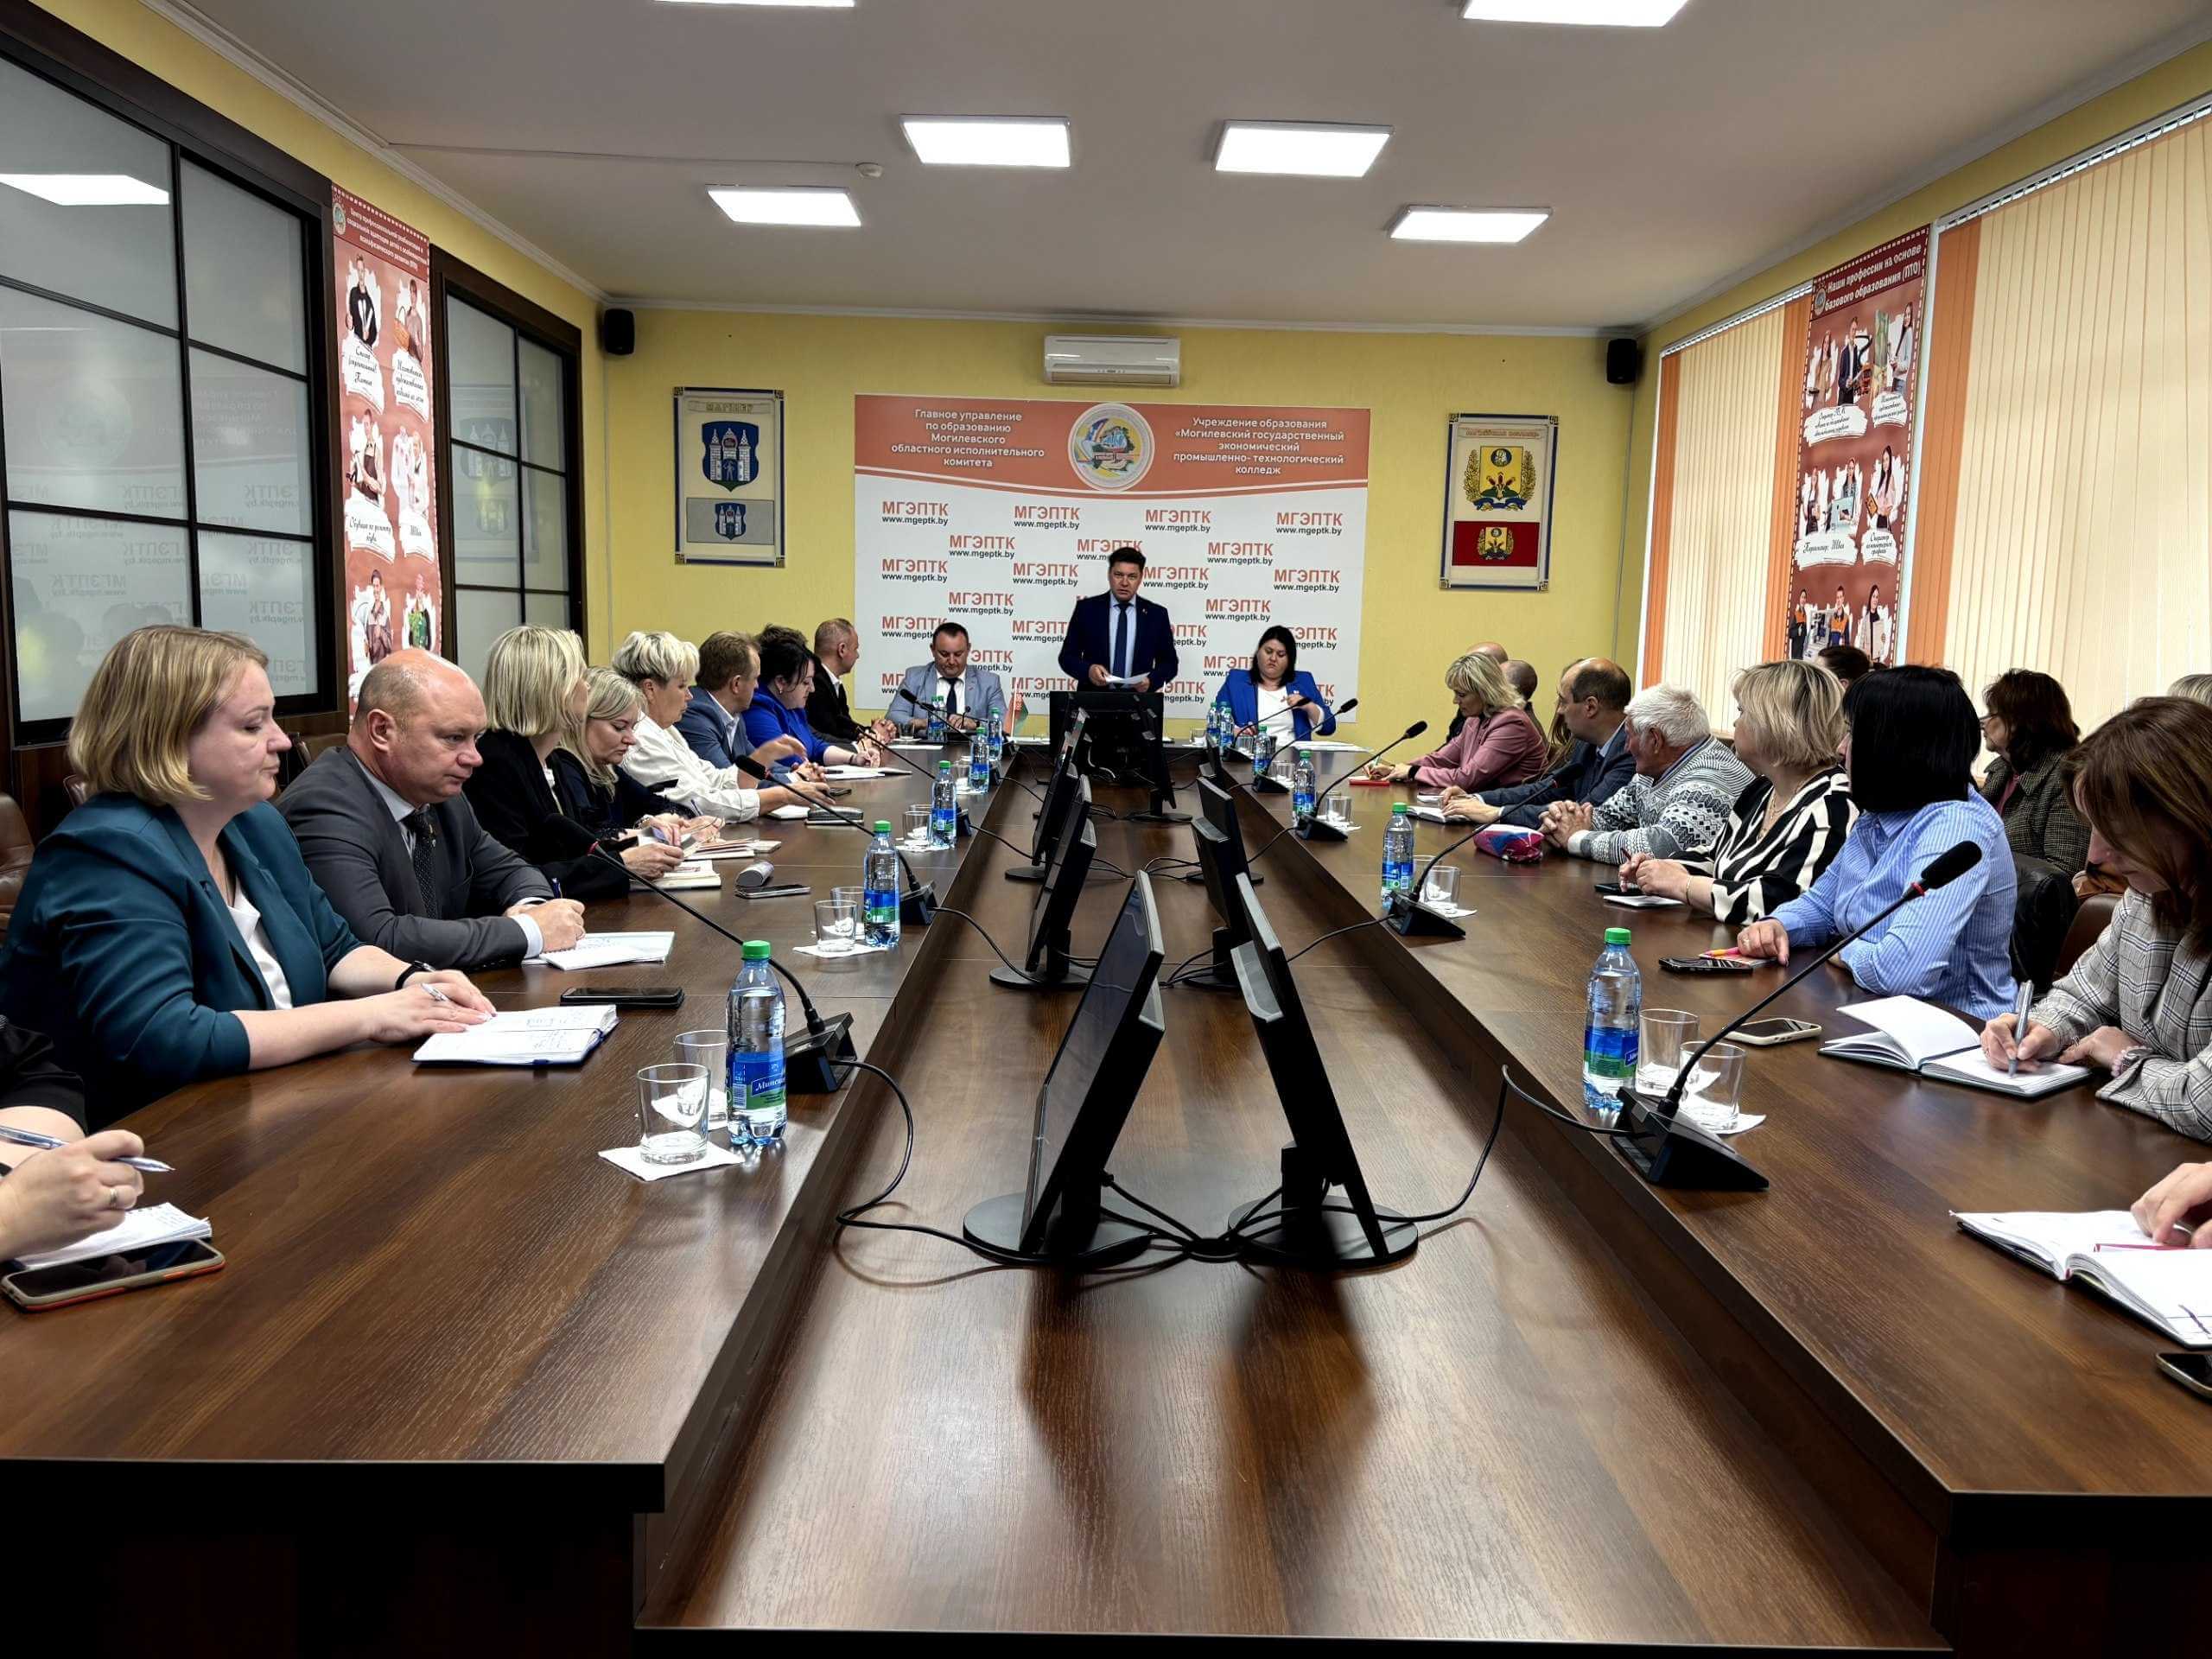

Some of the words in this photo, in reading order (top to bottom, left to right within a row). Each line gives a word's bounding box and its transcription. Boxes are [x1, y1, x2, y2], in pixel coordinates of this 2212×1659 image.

[1827, 279, 1846, 293] Наши
[1847, 262, 1883, 286] профессии
[1885, 255, 1893, 268] на
[1894, 244, 1922, 263] основе
[1825, 293, 1854, 311] базового
[1855, 272, 1901, 299] образования
[1902, 260, 1921, 282] (ПТО)
[915, 410, 957, 420] Главное
[960, 411, 1022, 422] управление
[941, 423, 1011, 433] образованию
[1192, 418, 1257, 428] Учреждение
[1260, 420, 1327, 429] образования
[931, 434, 1006, 444] Могилевского
[1175, 429, 1250, 439] «Могилевский
[1253, 431, 1344, 442] государственный
[891, 444, 951, 454] областного
[953, 447, 1044, 457] исполнительного
[1218, 442, 1300, 452] экономический
[944, 458, 993, 467] комитета
[1173, 453, 1251, 463] промышленно-
[1253, 454, 1344, 465] технологический
[1236, 466, 1281, 475] колледж
[882, 501, 948, 516] МГЭПТК
[1014, 505, 1079, 520] МГЭПТК
[882, 517, 948, 526] www.mgeptk.by
[1146, 509, 1211, 524] МГЭПТК
[1276, 512, 1343, 526] МГЭПТК
[1014, 520, 1079, 530] www.mgeptk.by
[1145, 524, 1211, 533] www.mgeptk.by
[1276, 526, 1342, 536] www.mgeptk.by
[950, 535, 1014, 549] МГЭПТК
[950, 549, 1014, 559] www.mgeptk.by
[1208, 542, 1273, 556] МГЭПТК
[882, 559, 947, 574] МГЭПТК
[1207, 556, 1273, 565] www.mgeptk.by
[1014, 563, 1077, 577] МГЭПТК
[1143, 567, 1209, 581] МГЭПТК
[1274, 569, 1339, 583] МГЭПТК
[882, 574, 947, 583] www.mgeptk.by
[1013, 577, 1077, 587] www.mgeptk.by
[1143, 580, 1209, 590] www.mgeptk.by
[1274, 584, 1339, 594] www.mgeptk.by
[949, 592, 1014, 607] МГЭПТК
[1206, 599, 1271, 612] МГЭПТК
[949, 607, 1014, 616] www.mgeptk.by
[1205, 613, 1270, 622] www.mgeptk.by
[1013, 620, 1067, 634] МГЭПТ
[1170, 624, 1207, 637] ПТК
[1012, 635, 1065, 644] www.mgeptk
[1286, 627, 1338, 640] ЭПТК
[1173, 638, 1206, 648] eptk.by
[971, 650, 1014, 663] ЭПТК
[1204, 656, 1253, 669] МГЭП
[1165, 681, 1205, 694] ЭПТК
